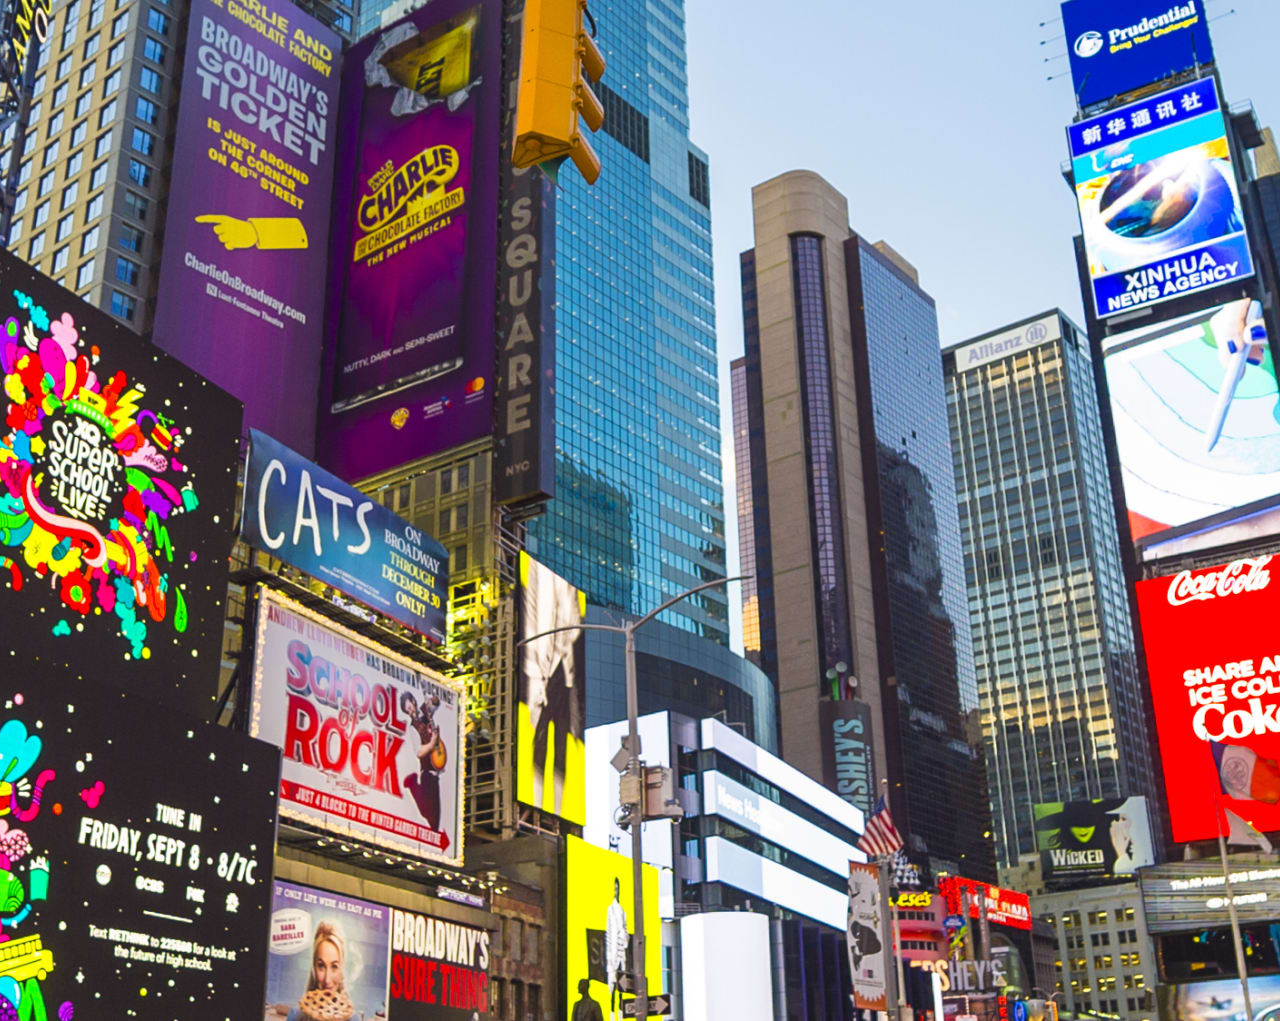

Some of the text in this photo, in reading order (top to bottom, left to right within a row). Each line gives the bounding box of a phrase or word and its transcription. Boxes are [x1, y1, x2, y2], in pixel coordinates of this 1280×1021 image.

[227, 0, 332, 78] CHOCOLATE FACTORY
[294, 28, 333, 61] AND
[1108, 0, 1197, 45] Prudential
[201, 15, 329, 117] BROADWAY'S
[196, 66, 326, 166] TICKET
[198, 45, 327, 142] GOLDEN
[1082, 91, 1203, 146] 新华通讯社
[207, 117, 310, 185] IS JUST AROUND
[220, 138, 297, 192] THE CORNER
[208, 147, 228, 167] ON
[260, 178, 305, 210] STREET
[360, 147, 453, 228] CHARLIE
[367, 211, 422, 251] CHOCOLATE
[423, 191, 462, 220] FACTORY
[184, 251, 307, 325] CharlieOnBroadway.com
[1107, 261, 1239, 311] NEWS AGENCY
[1124, 251, 1217, 292] XINHUA
[506, 196, 539, 435] SQUARE
[370, 348, 393, 365] DARK
[405, 324, 457, 351] SEMI-SWEET
[967, 332, 1023, 364] Allianz
[74, 416, 101, 448] XQ
[48, 451, 113, 504] SCHOOL
[505, 460, 530, 477] NYC
[58, 480, 99, 518] LIVE
[258, 458, 374, 557] CATS
[384, 528, 440, 575] BROADWAY
[405, 525, 422, 546] ON
[381, 564, 431, 604] DECEMBER
[430, 593, 441, 609] 30
[389, 551, 436, 589] THROUGH
[395, 592, 426, 619] ONLY!
[286, 639, 407, 737] SCHOOL
[366, 652, 381, 672] HAS
[382, 659, 420, 691] BROADWAY
[1182, 659, 1256, 687] SHARE
[1188, 684, 1228, 707] ICE
[283, 691, 405, 799] ROCK
[156, 802, 202, 832] TUNE IN
[295, 786, 442, 847] JUST 4 BLOCKS TO THE WINTER GARDEN THEATRE
[78, 816, 258, 886] FRIDAY, SEPT 8 8/7C
[283, 888, 302, 900] ONLY
[303, 892, 318, 904] LIFE
[319, 895, 338, 908] WERE
[338, 900, 347, 911] AS
[347, 902, 364, 915] EASY
[89, 923, 109, 940] Text
[150, 936, 160, 948] to
[192, 942, 205, 956] for
[210, 945, 227, 959] look
[114, 944, 129, 957] the
[130, 945, 156, 962] future
[156, 951, 166, 964] of
[166, 953, 184, 969] high
[393, 908, 490, 970] BROADWAY'S
[391, 953, 489, 1013] SURE THING
